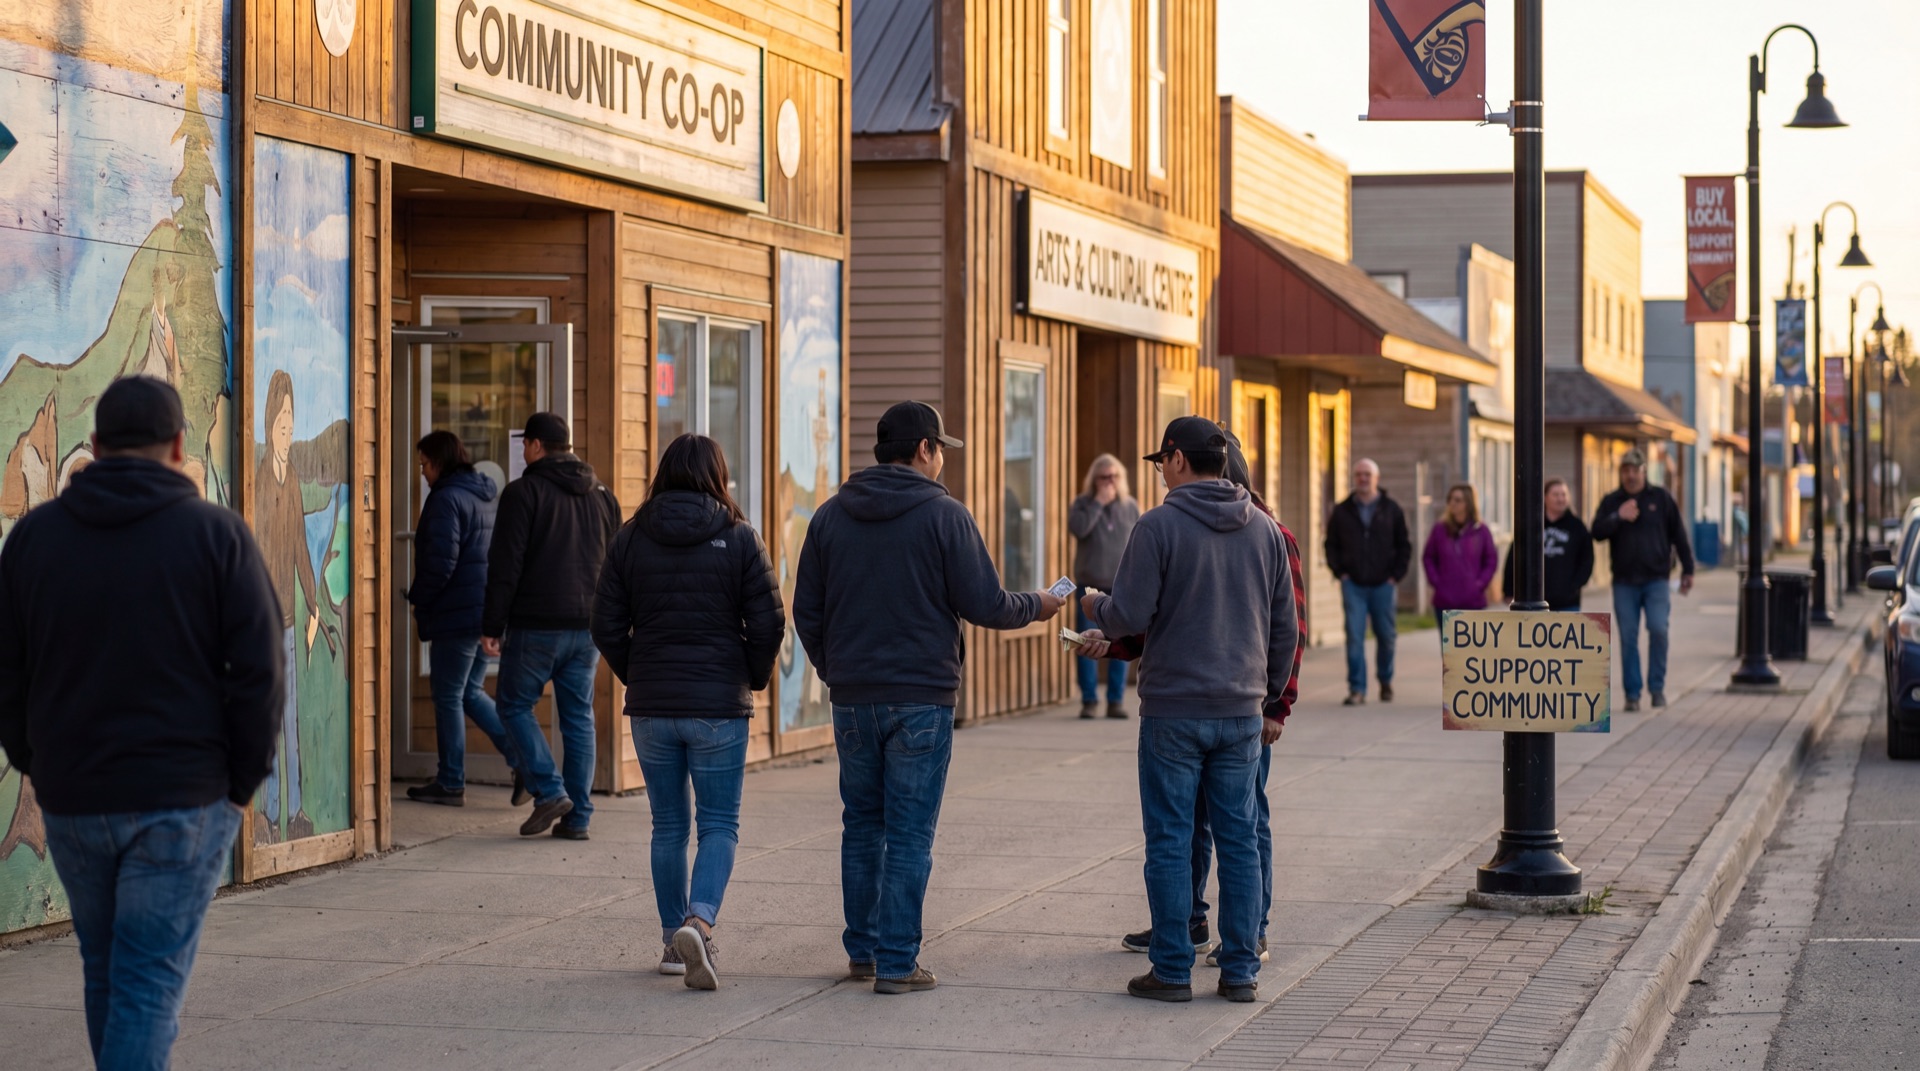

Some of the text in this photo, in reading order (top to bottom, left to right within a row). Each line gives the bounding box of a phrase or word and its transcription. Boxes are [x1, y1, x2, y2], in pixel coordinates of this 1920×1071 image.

[455, 0, 744, 146] COMMUNITY CO-OP
[1695, 186, 1726, 206] BUY
[1688, 232, 1734, 250] SUPPORT
[1035, 228, 1193, 318] ARTS & CULTURAL CENTRE
[1454, 620, 1603, 654] BUY LOCAL,
[1463, 656, 1583, 686] SUPPORT
[1452, 690, 1601, 722] COMMUNITY
